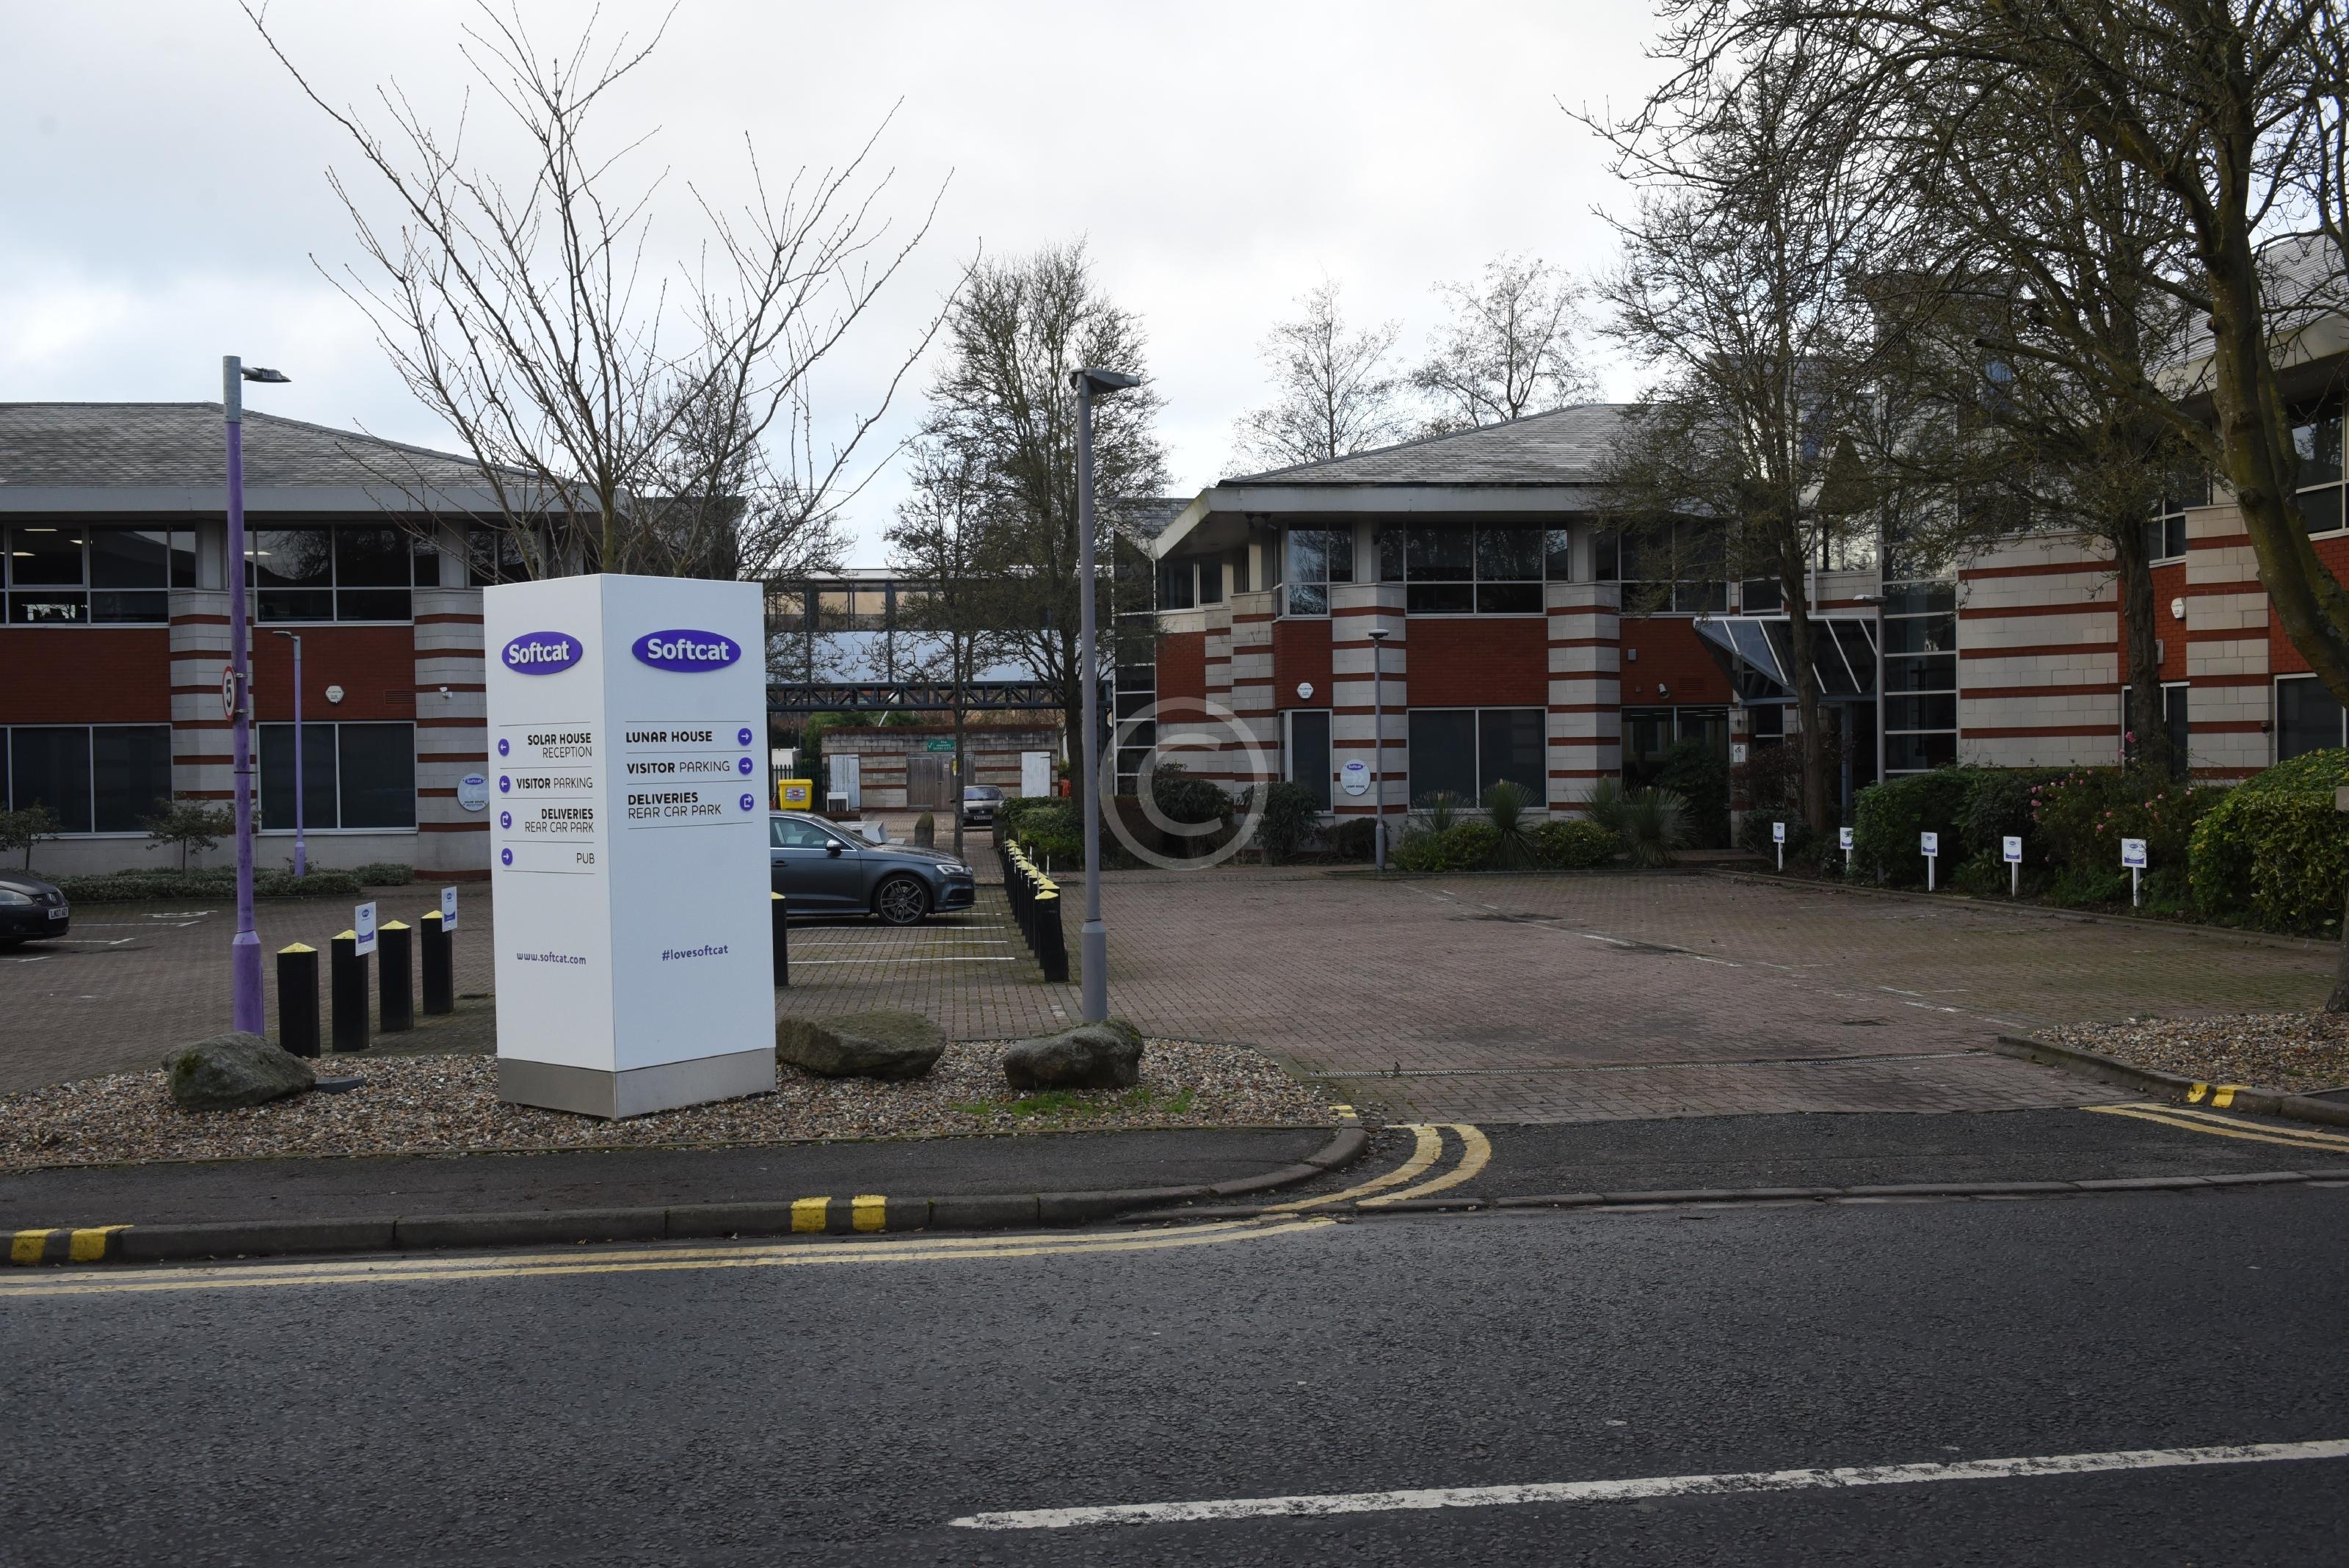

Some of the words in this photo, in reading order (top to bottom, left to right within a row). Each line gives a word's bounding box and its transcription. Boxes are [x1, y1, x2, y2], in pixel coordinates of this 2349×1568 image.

[509, 641, 570, 664] Softcat
[647, 638, 730, 661] Softcat
[226, 678, 232, 708] 5
[527, 733, 557, 746] SOLAR
[559, 732, 592, 745] HOUSE
[625, 731, 667, 744] LUNAR
[671, 730, 713, 743] HOUSE
[542, 746, 593, 758] RECEPTION
[626, 762, 675, 774] VISITOR
[679, 760, 730, 773] PARKING
[516, 777, 551, 789] VISITOR
[553, 777, 593, 789] PARKING
[628, 792, 699, 806] DELIVERIES
[541, 808, 595, 821] DELIVERIES
[628, 807, 661, 820] REAR
[664, 805, 689, 819] CAR
[691, 804, 722, 816] PARK
[525, 821, 548, 833] REAR
[550, 821, 568, 833] CAR
[570, 821, 595, 833] PARK
[576, 852, 595, 865] PUB
[516, 951, 587, 965] www.softcat.com
[661, 945, 729, 962] #lovesoftcat
